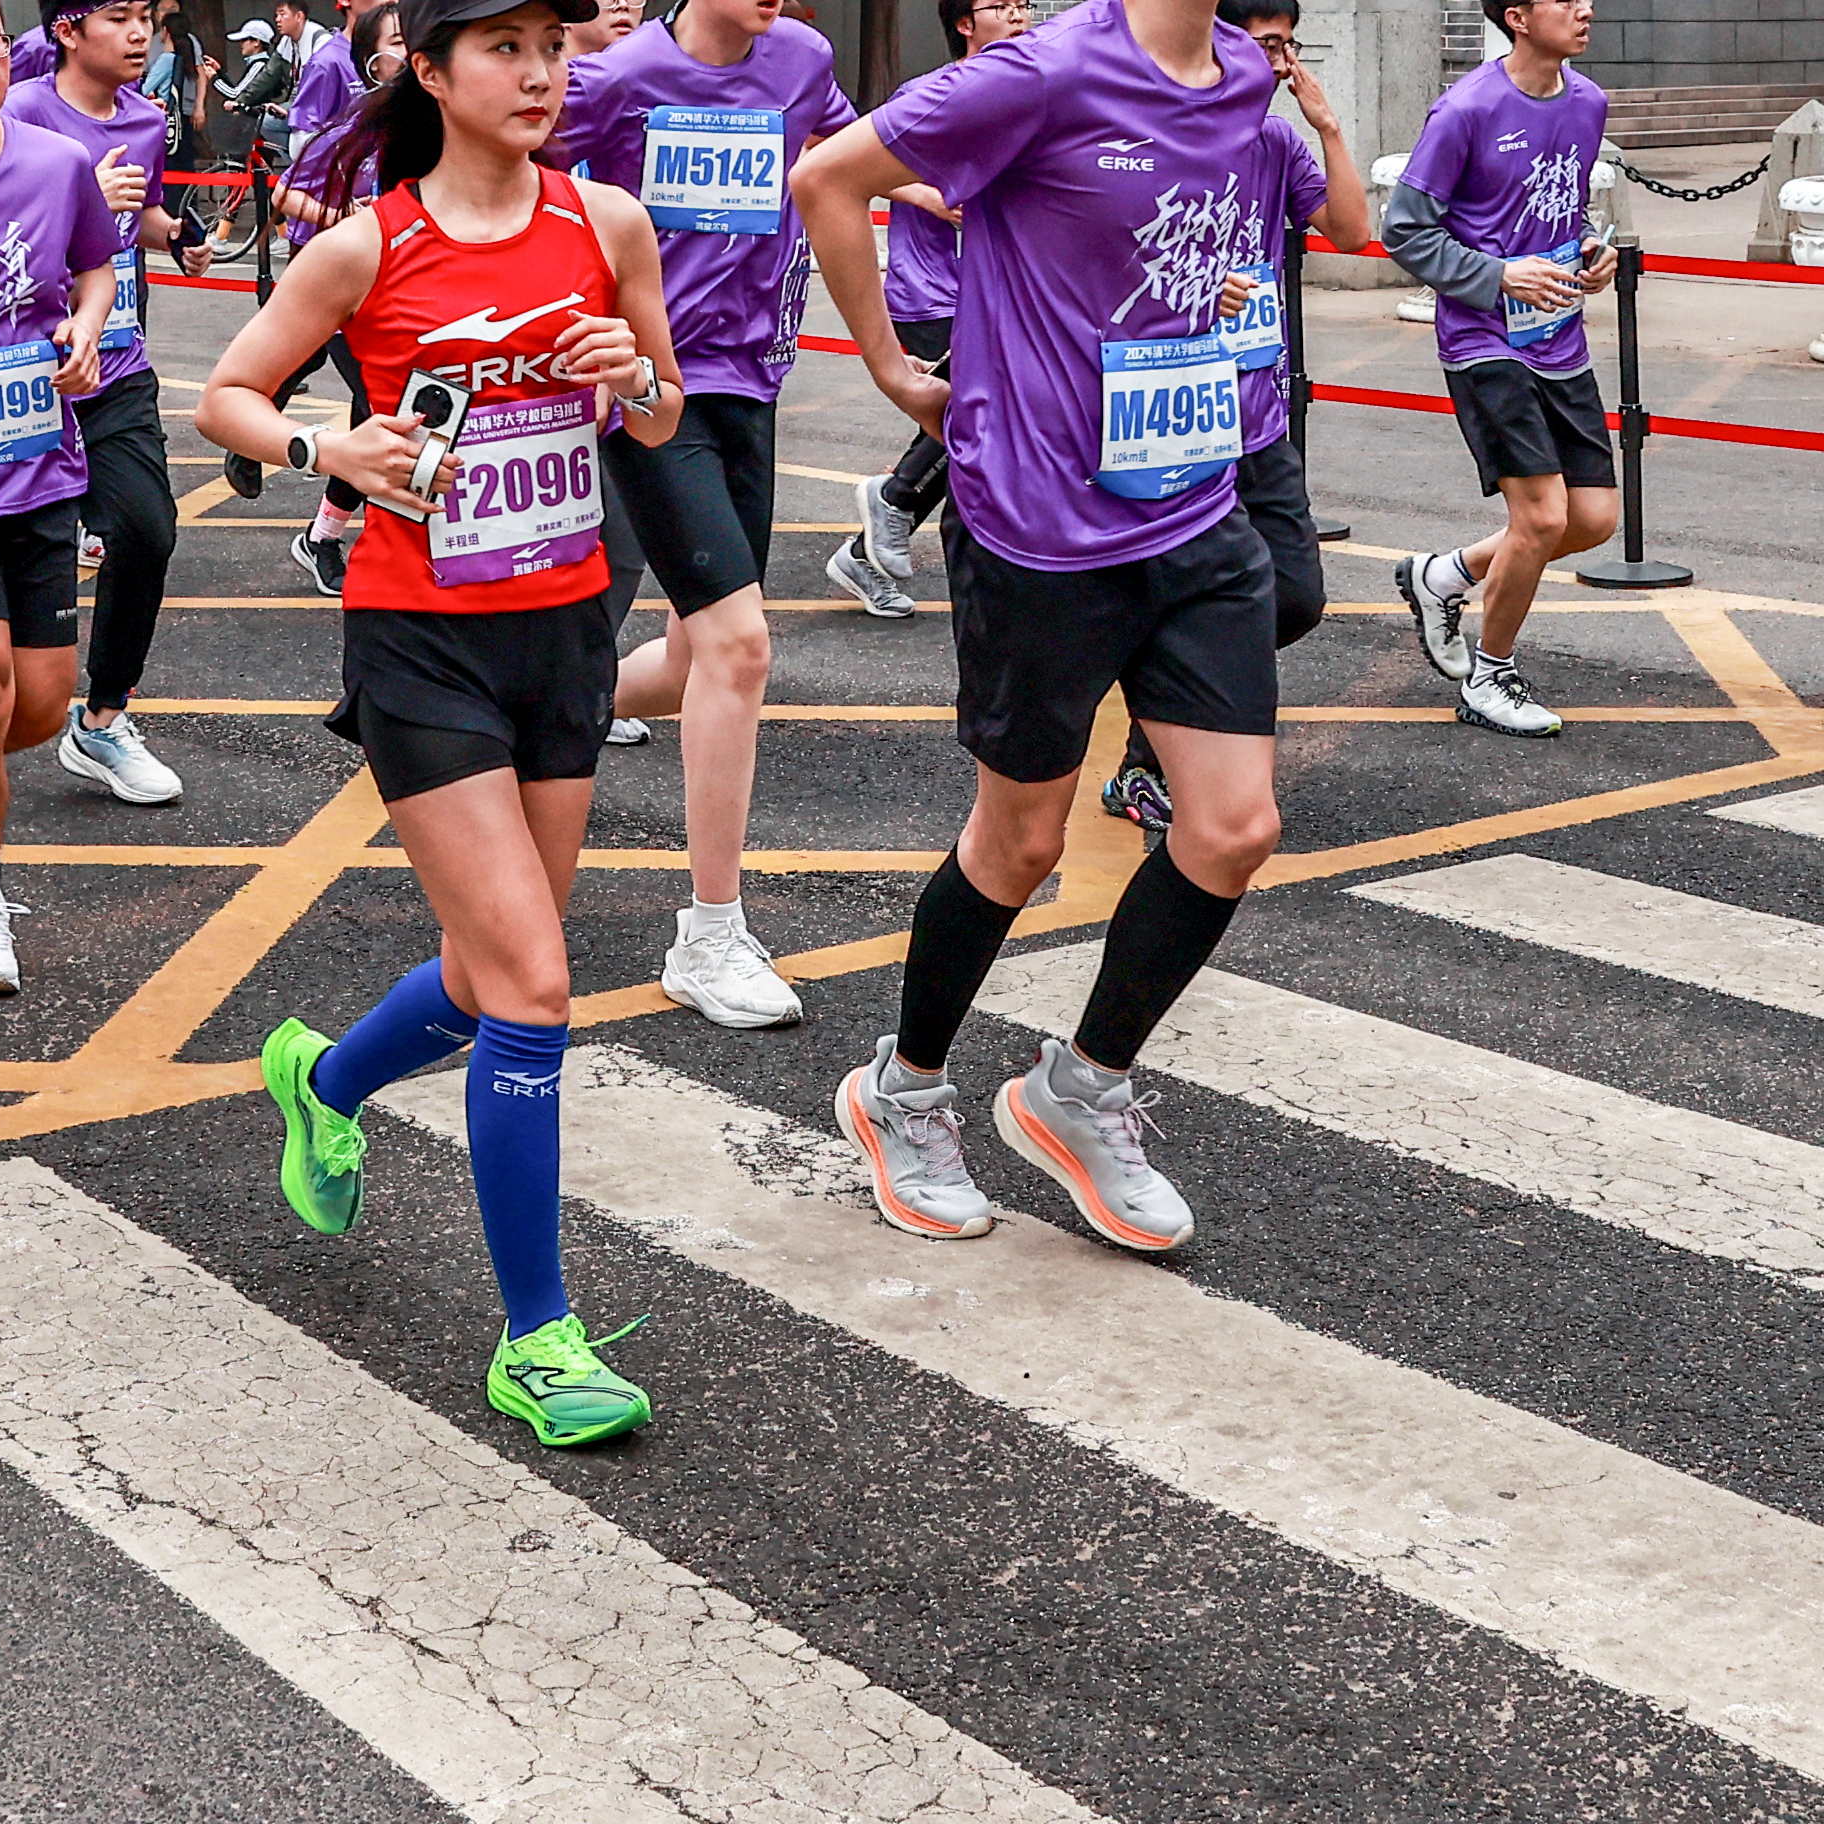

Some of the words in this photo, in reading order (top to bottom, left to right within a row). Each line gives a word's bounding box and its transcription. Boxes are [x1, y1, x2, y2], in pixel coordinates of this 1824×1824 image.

[1498, 140, 1528, 152] ERKE
[654, 145, 776, 188] M5142
[1098, 156, 1155, 172] ERKE
[115, 278, 135, 311] 88
[461, 400, 583, 434] 24清华大学校园马拉松
[1109, 379, 1236, 442] M4955
[483, 428, 521, 439] UNIVERSITY
[521, 423, 551, 434] CAMPUS
[444, 445, 592, 524] F2096
[444, 532, 480, 550] 半程组
